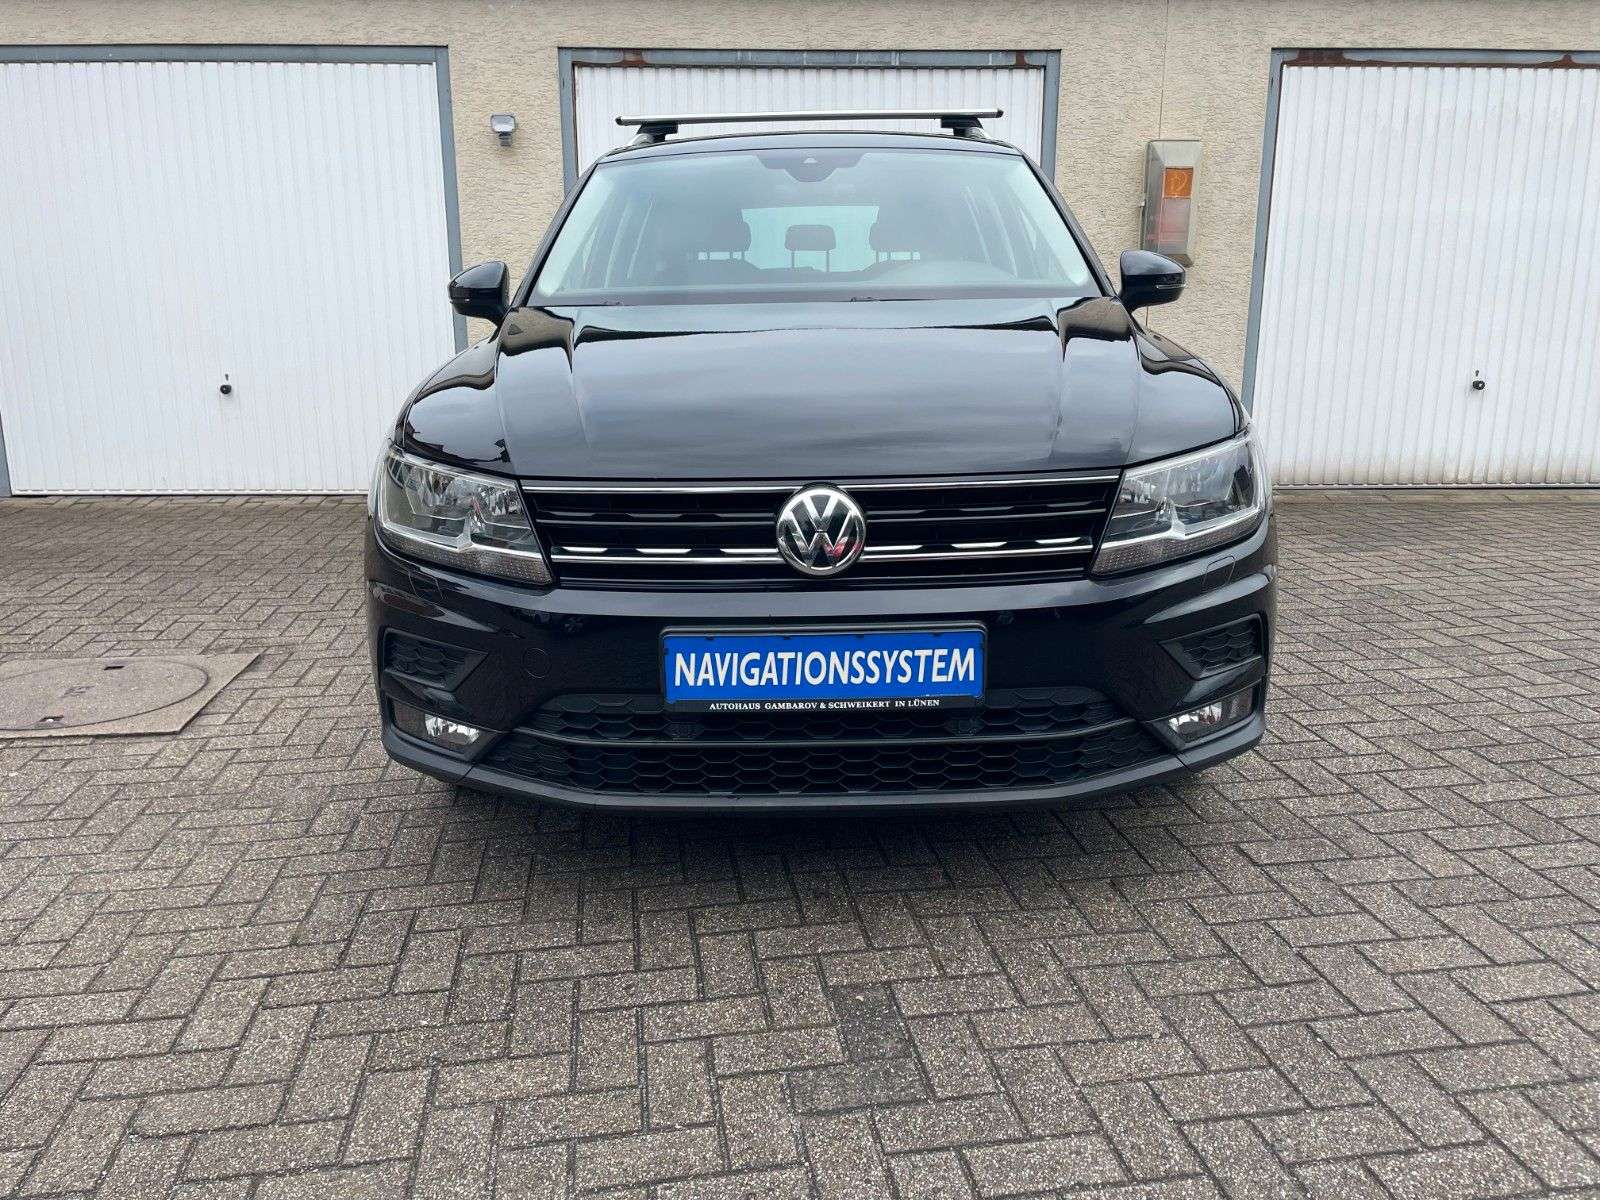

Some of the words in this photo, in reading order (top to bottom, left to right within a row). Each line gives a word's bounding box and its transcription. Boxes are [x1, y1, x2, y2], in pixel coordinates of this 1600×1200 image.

[777, 488, 866, 576] VW
[675, 648, 975, 686] NAVIGATIONSSYSTEM
[709, 702, 761, 711] AUTOHAUS
[765, 702, 818, 711] GAMBAROV
[819, 701, 827, 710] &
[828, 700, 891, 710] SCHWEIKERT
[895, 699, 906, 708] IN
[908, 697, 940, 708] LÜNEN
